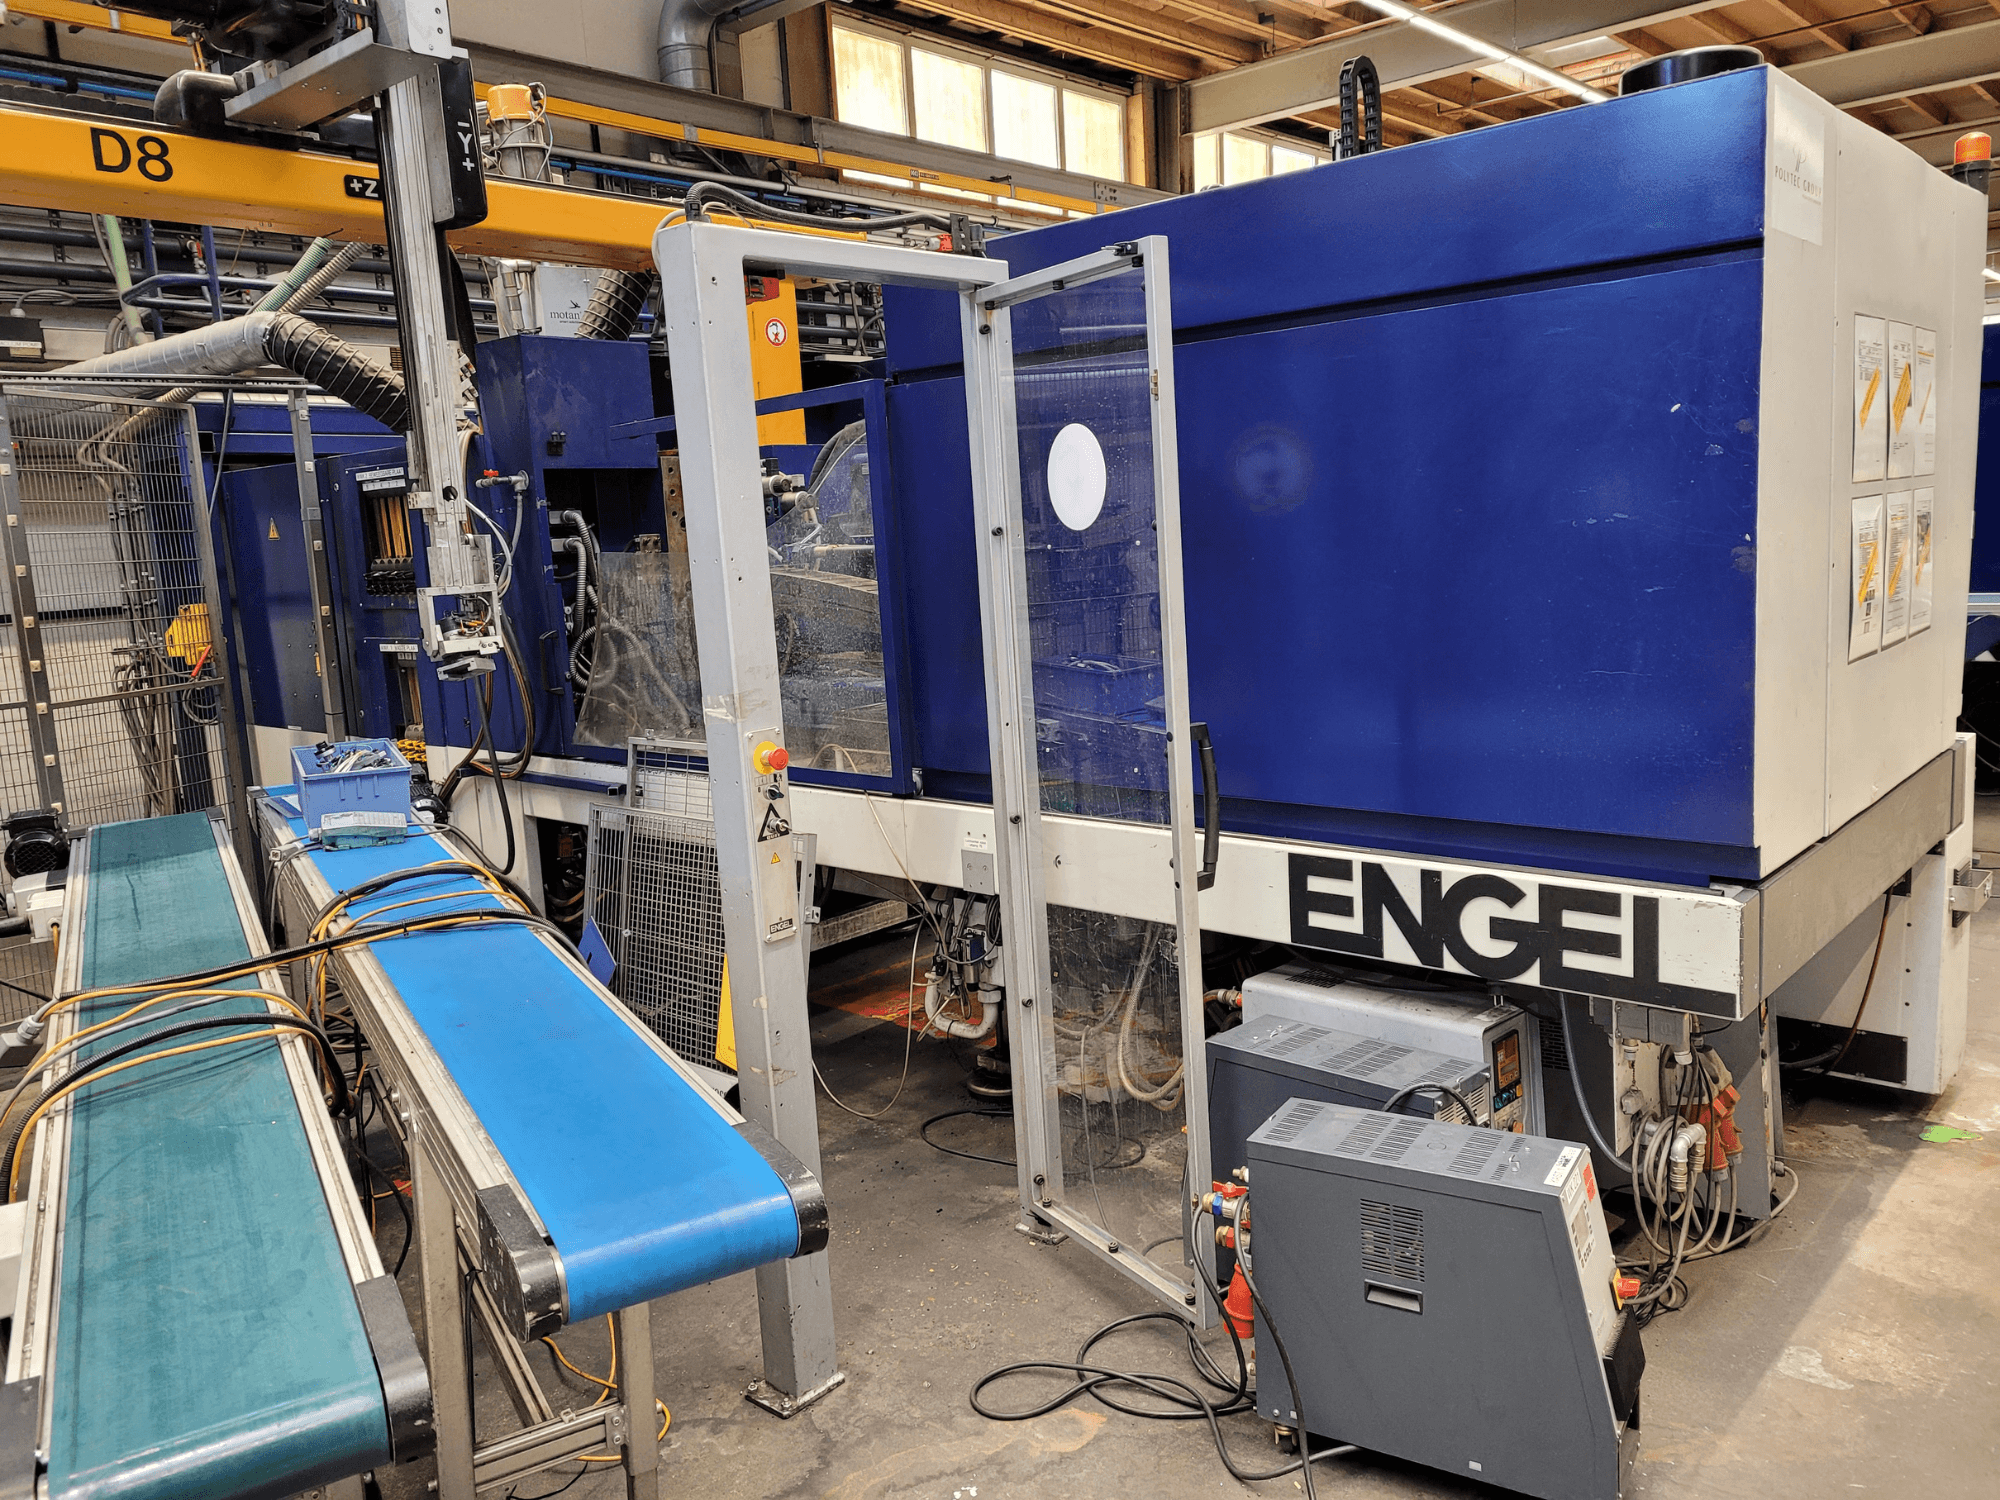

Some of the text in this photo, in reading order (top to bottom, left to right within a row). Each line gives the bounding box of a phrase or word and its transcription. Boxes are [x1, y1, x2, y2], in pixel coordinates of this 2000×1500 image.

[90, 126, 174, 182] D8
[350, 178, 379, 198] +Z
[1774, 165, 1801, 189] POLYTEC
[770, 919, 793, 933] ENGEL
[1287, 852, 1738, 1019] ENGEL
